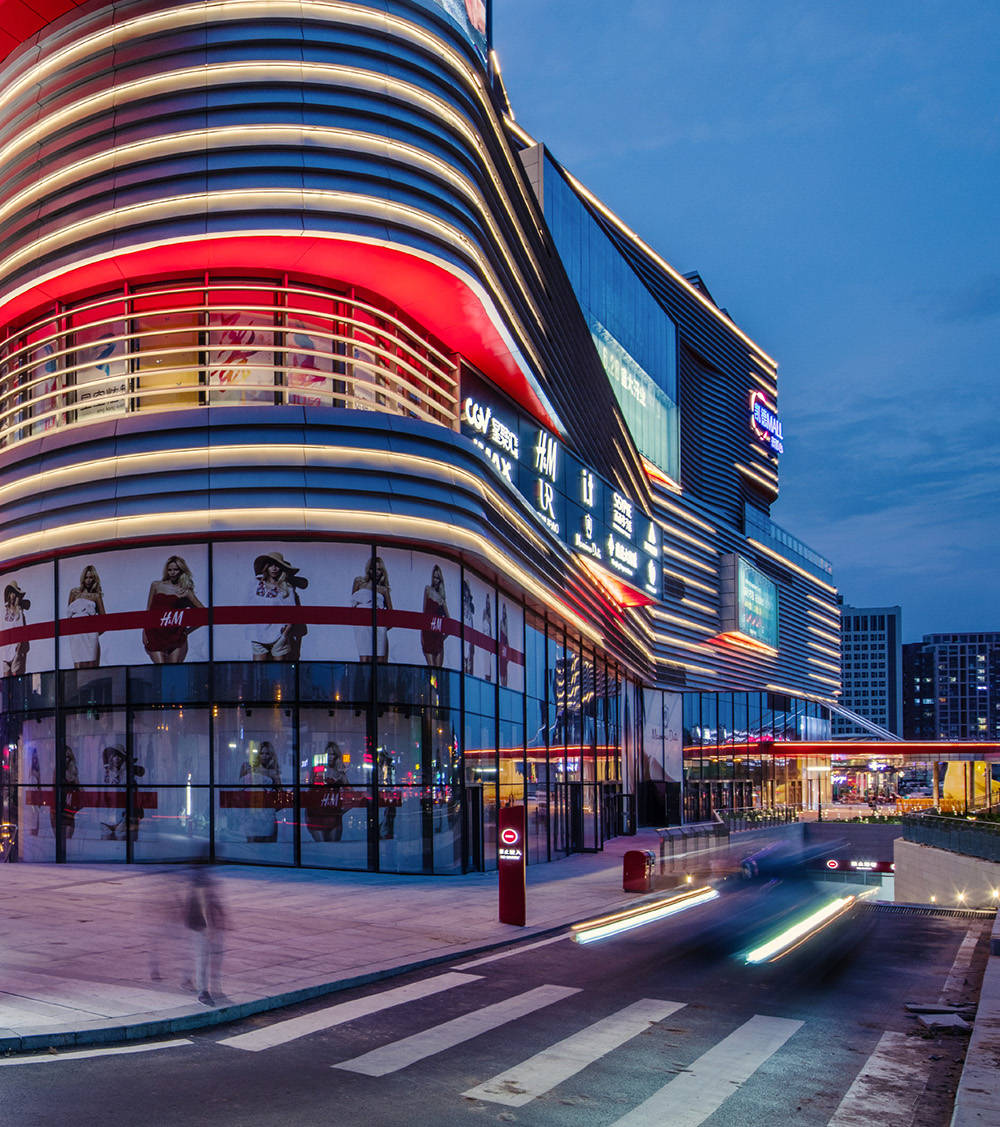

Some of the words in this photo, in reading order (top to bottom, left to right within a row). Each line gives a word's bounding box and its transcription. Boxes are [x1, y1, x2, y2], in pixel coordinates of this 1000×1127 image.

[465, 397, 492, 434] CGV
[535, 429, 558, 483] H&M
[538, 477, 556, 520] UR
[160, 610, 184, 627] H&M
[431, 616, 442, 632] H&M
